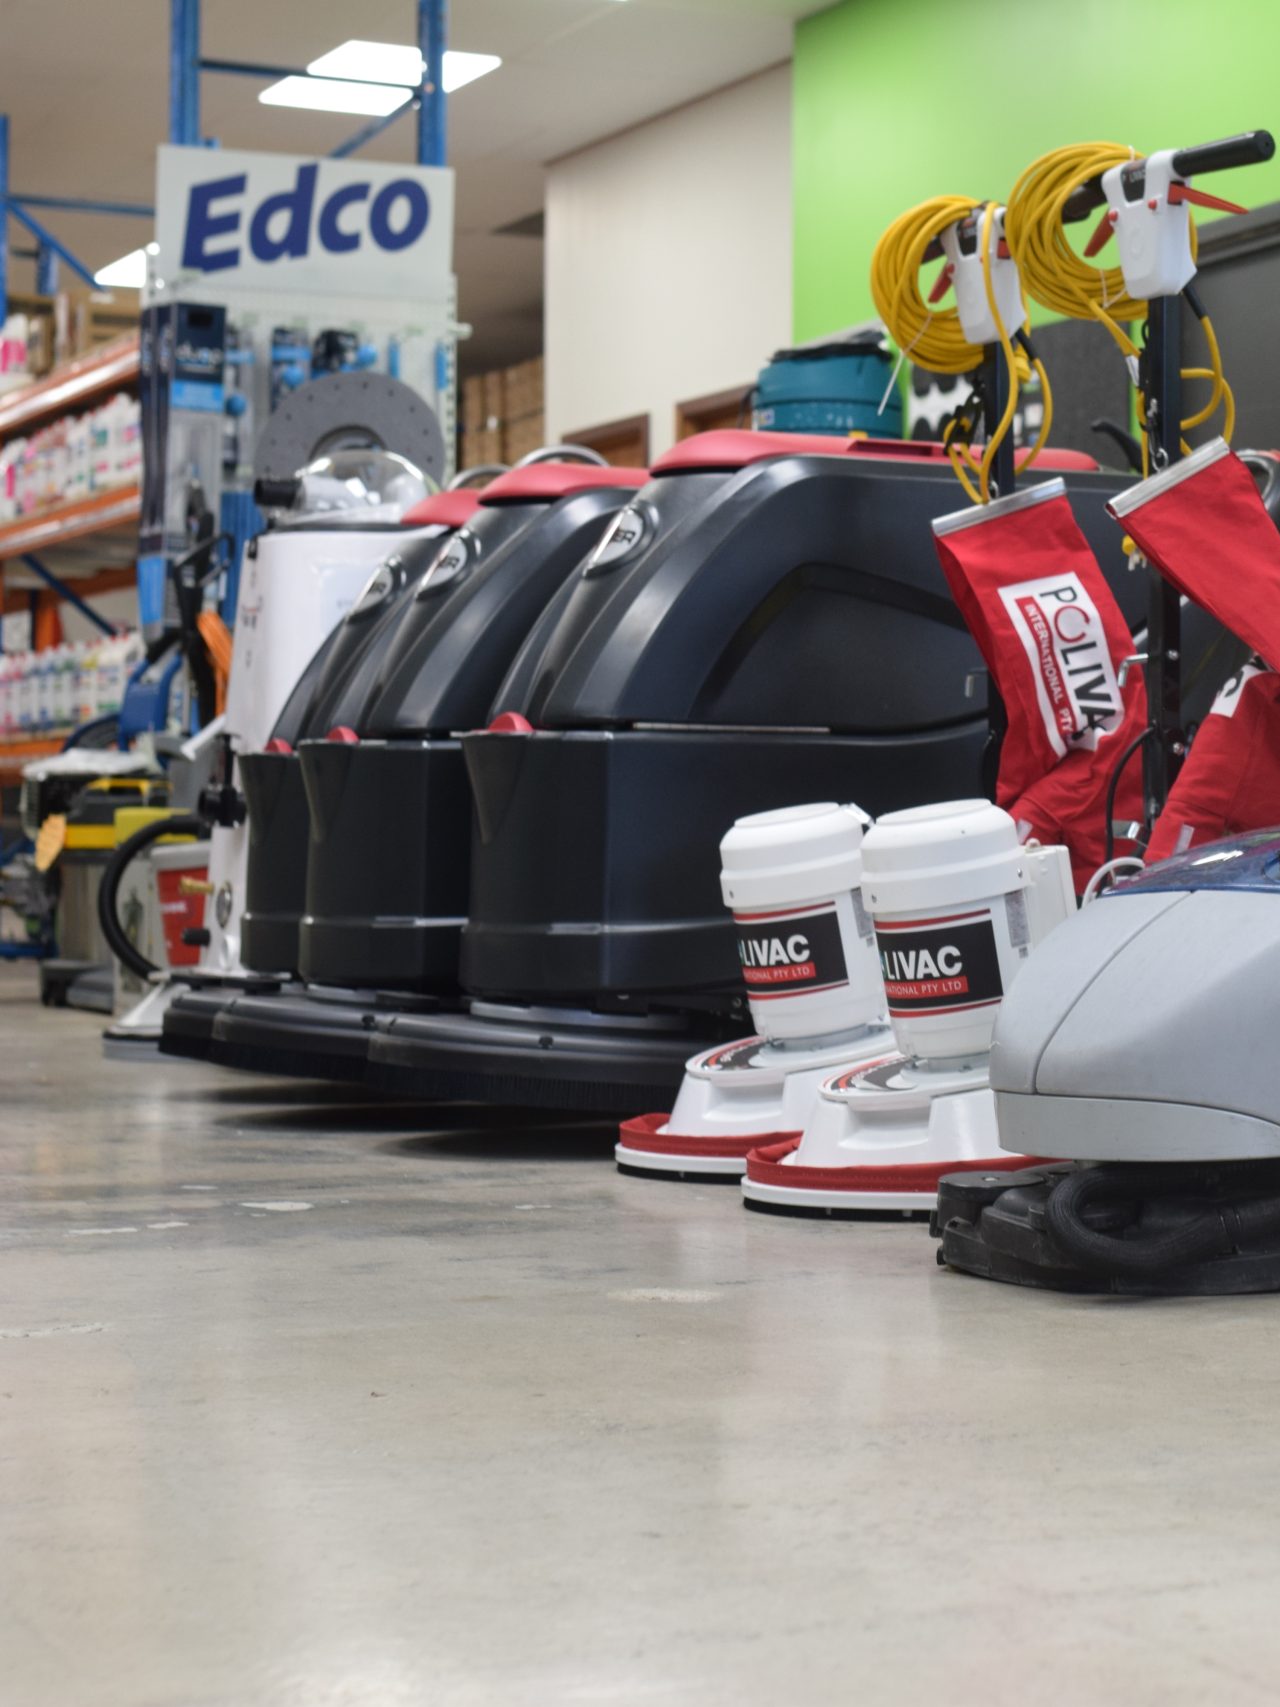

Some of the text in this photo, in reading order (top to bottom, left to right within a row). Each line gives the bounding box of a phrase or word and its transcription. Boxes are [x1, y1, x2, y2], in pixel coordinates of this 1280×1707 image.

[181, 162, 430, 275] Edco
[740, 934, 811, 967] LIVAC
[880, 945, 963, 981] LIVAC
[773, 967, 789, 979] PTY
[792, 966, 811, 977] LTD
[921, 982, 938, 994] PTY
[942, 981, 962, 992] LTD
